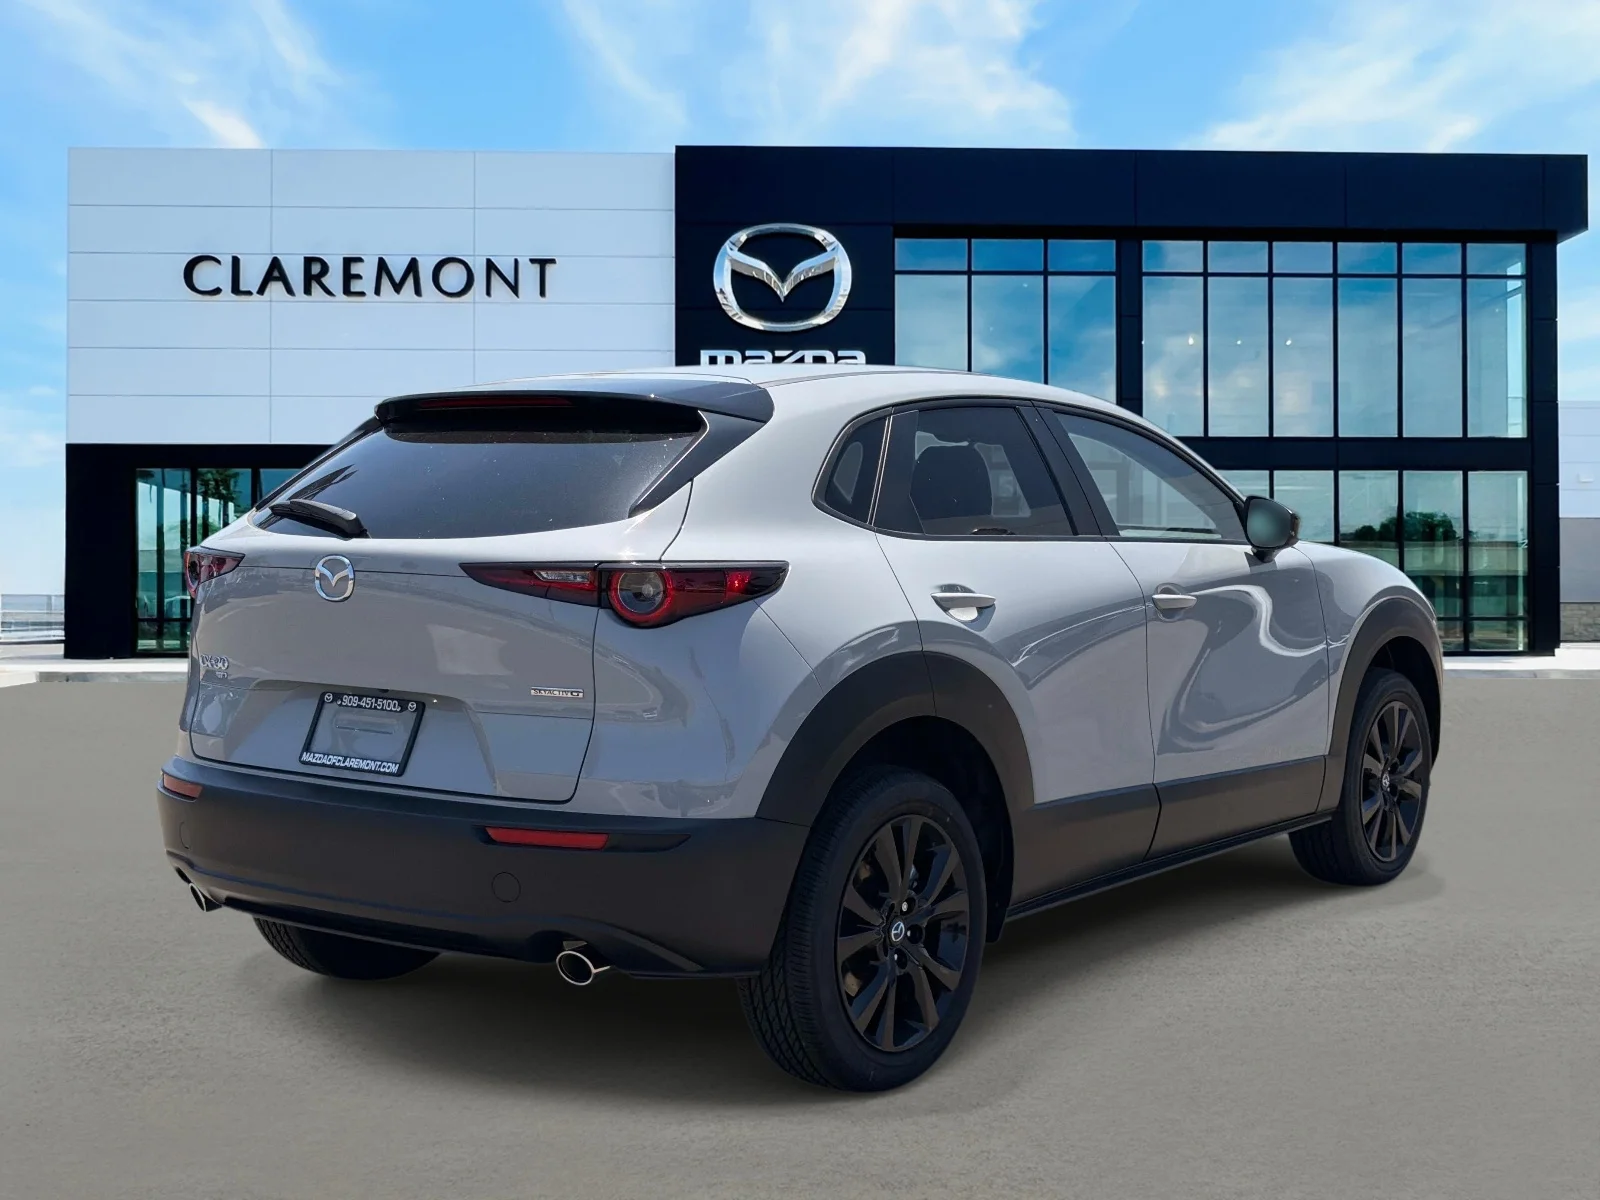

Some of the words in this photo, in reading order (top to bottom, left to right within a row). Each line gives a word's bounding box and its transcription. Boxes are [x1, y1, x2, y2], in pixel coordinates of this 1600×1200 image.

[183, 254, 557, 299] CLAREMONT
[342, 695, 399, 711] 909-451-5100
[301, 752, 399, 773] MAZDAOFCLAREMONT.COM
